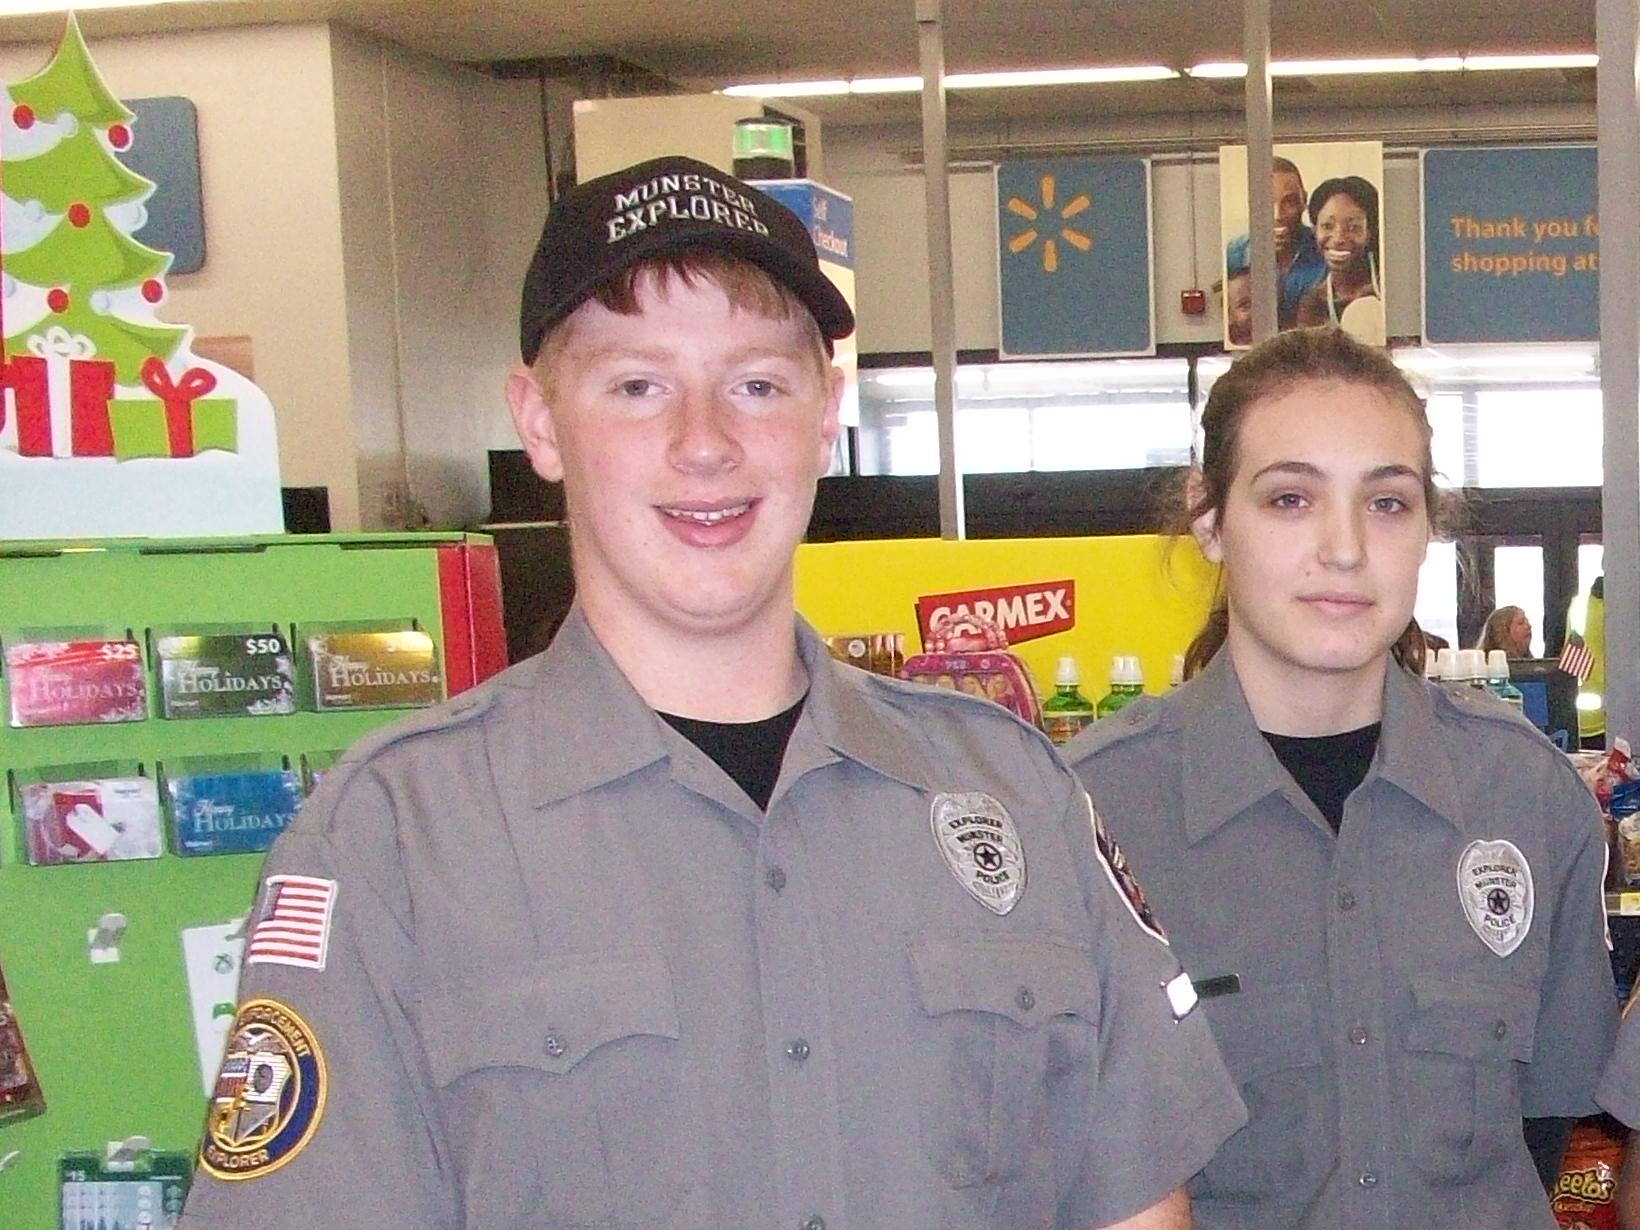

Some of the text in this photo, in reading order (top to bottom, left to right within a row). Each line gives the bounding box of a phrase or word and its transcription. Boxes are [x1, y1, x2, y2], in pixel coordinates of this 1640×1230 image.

[615, 174, 757, 215] MUNSTER
[607, 195, 769, 244] EXPLORER
[1451, 215, 1526, 238] Thank
[1533, 219, 1578, 242] you
[1452, 252, 1567, 276] shopping
[1573, 254, 1598, 271] at
[930, 589, 1069, 637] CARMEX
[246, 638, 280, 655] $50
[976, 870, 1010, 884] POLICE
[1472, 864, 1517, 877] EXPLORER
[1484, 914, 1515, 928] POLICE
[1554, 1171, 1611, 1199] eetos
